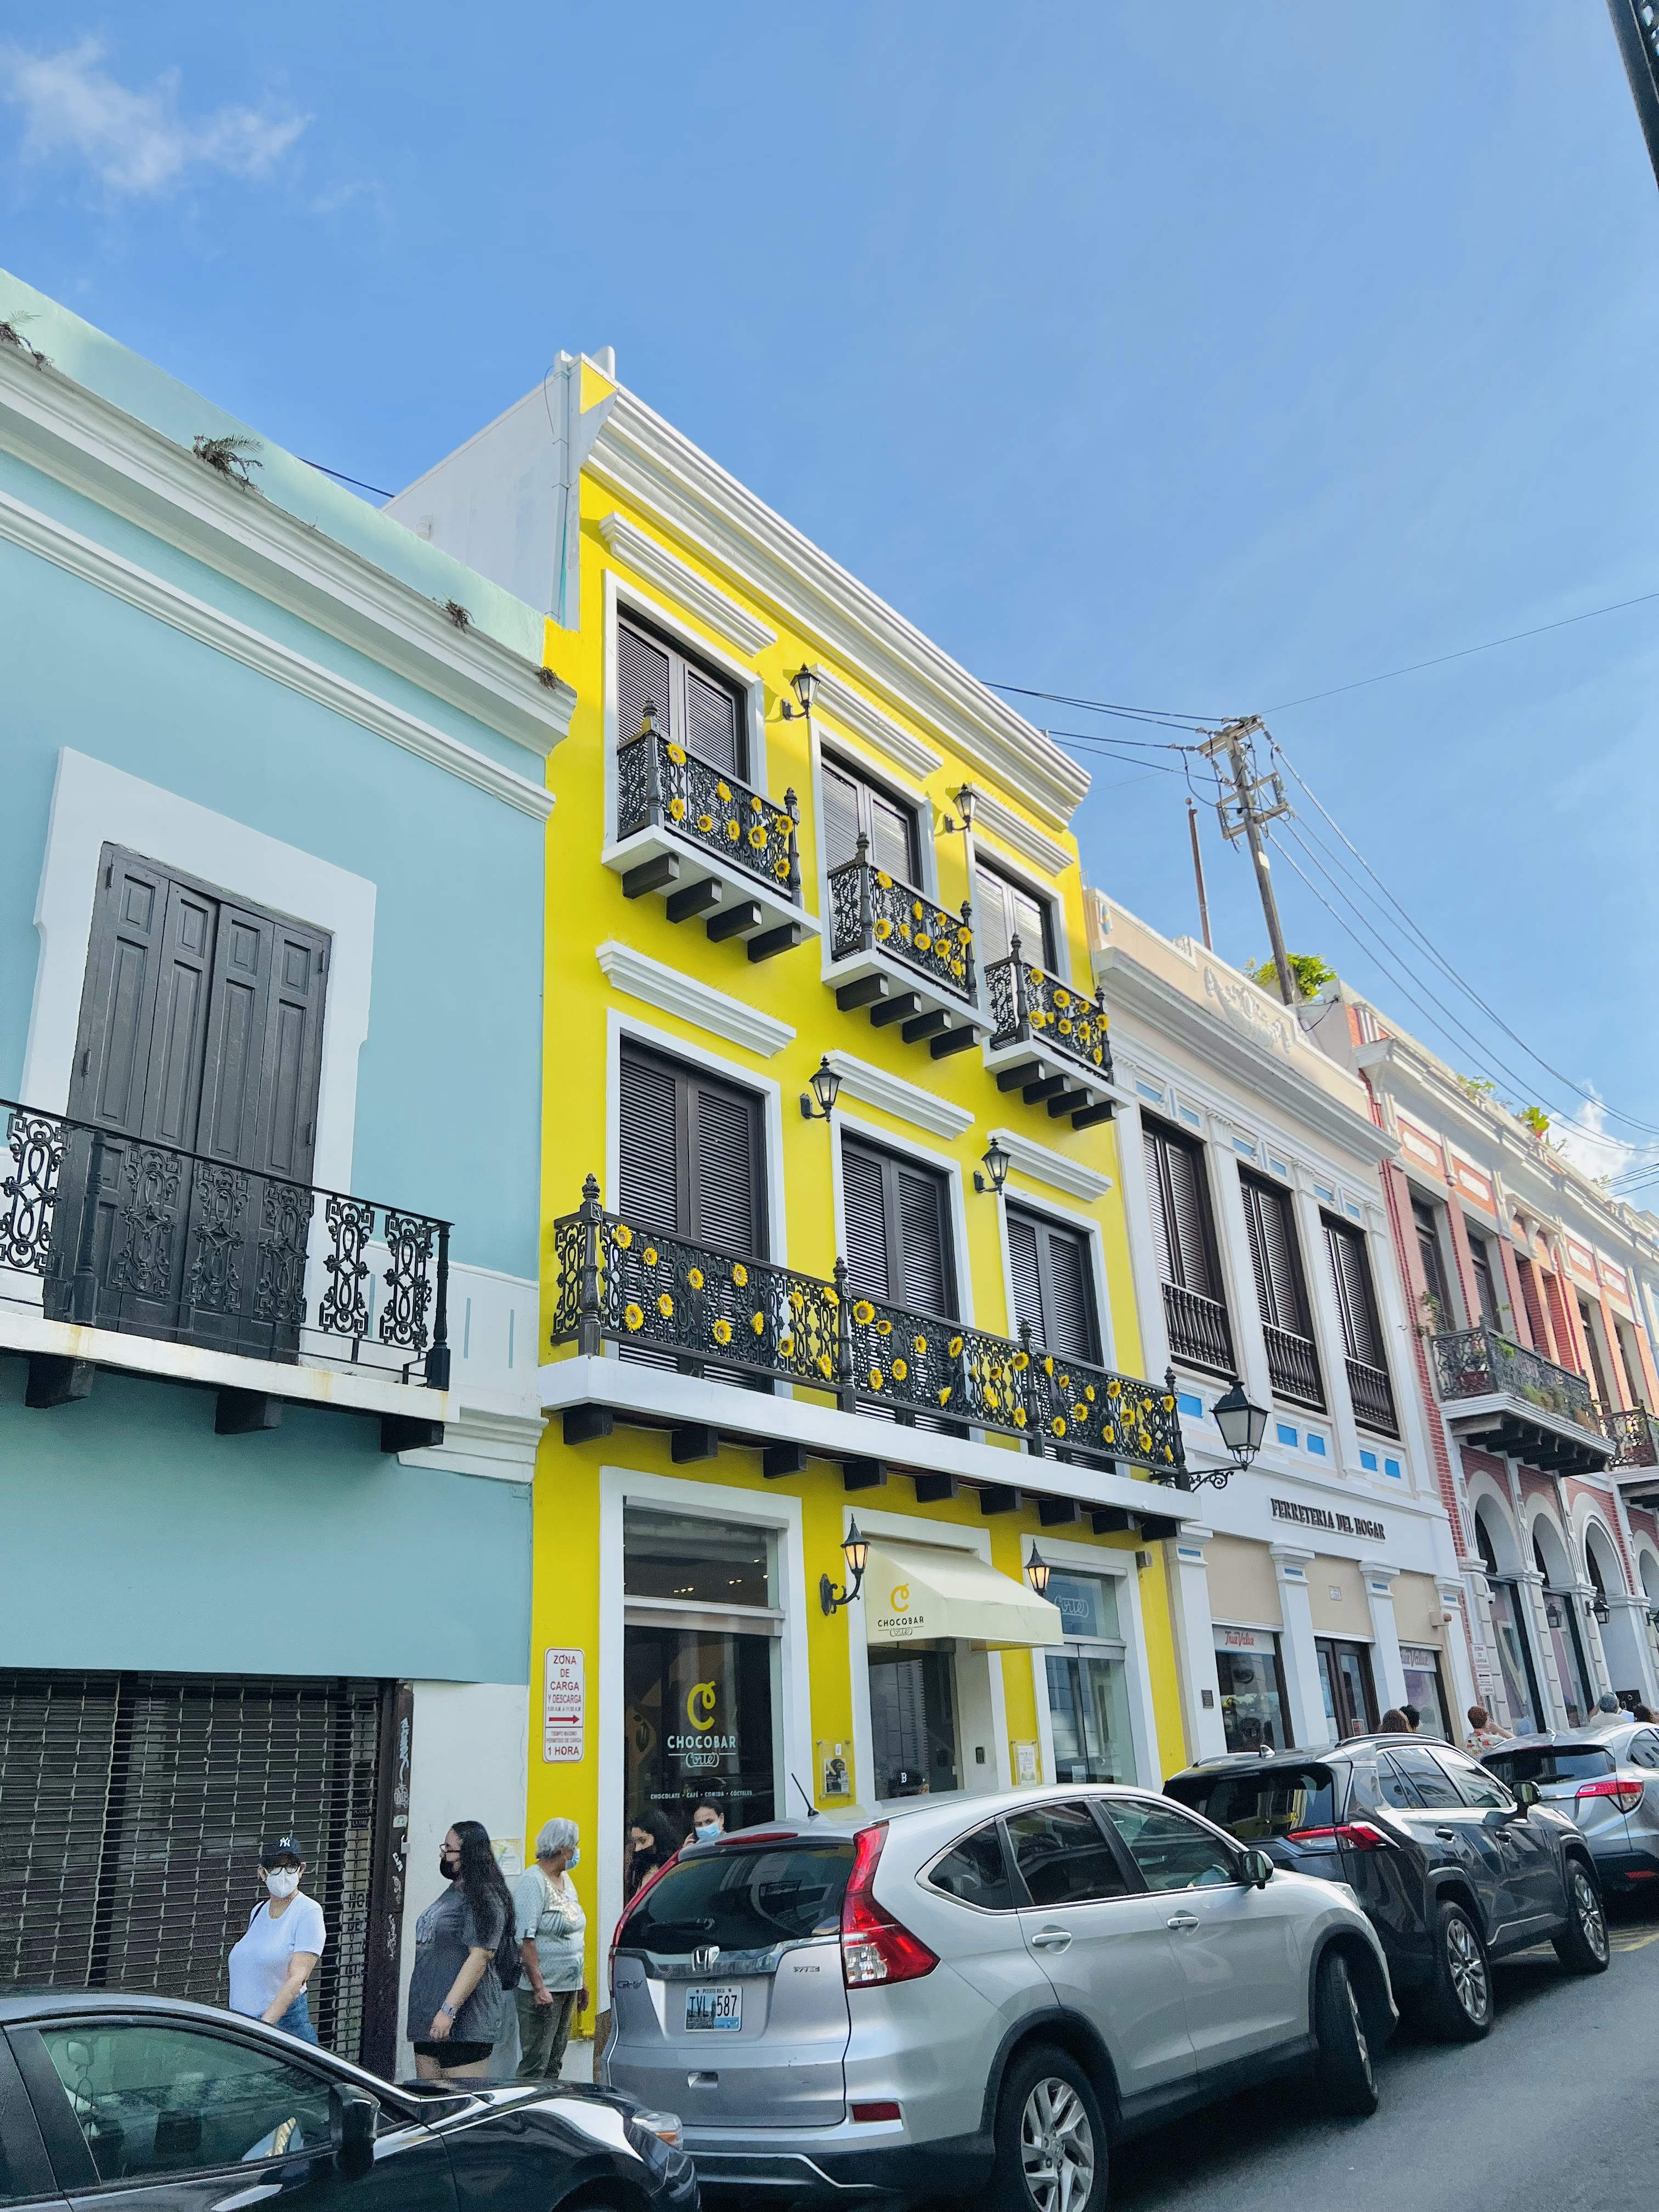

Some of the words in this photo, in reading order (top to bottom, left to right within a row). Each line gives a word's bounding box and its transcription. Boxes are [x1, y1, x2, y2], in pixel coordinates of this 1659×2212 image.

[1270, 1498, 1335, 1529] FERRETERIA
[1335, 1513, 1354, 1533] DEL
[1354, 1517, 1386, 1539] HOGAR
[877, 1616, 924, 1627] CHOCOBAR
[560, 1668, 570, 1678] DE
[550, 1681, 579, 1690] CARGA
[548, 1694, 551, 1703] Y
[552, 1694, 582, 1703] DESCARGA
[667, 1735, 737, 1749] CHOCOBAR
[548, 1746, 551, 1756] 1
[555, 1746, 579, 1756] HORA
[689, 1995, 709, 2018] IVL
[716, 1995, 737, 2017] 587
